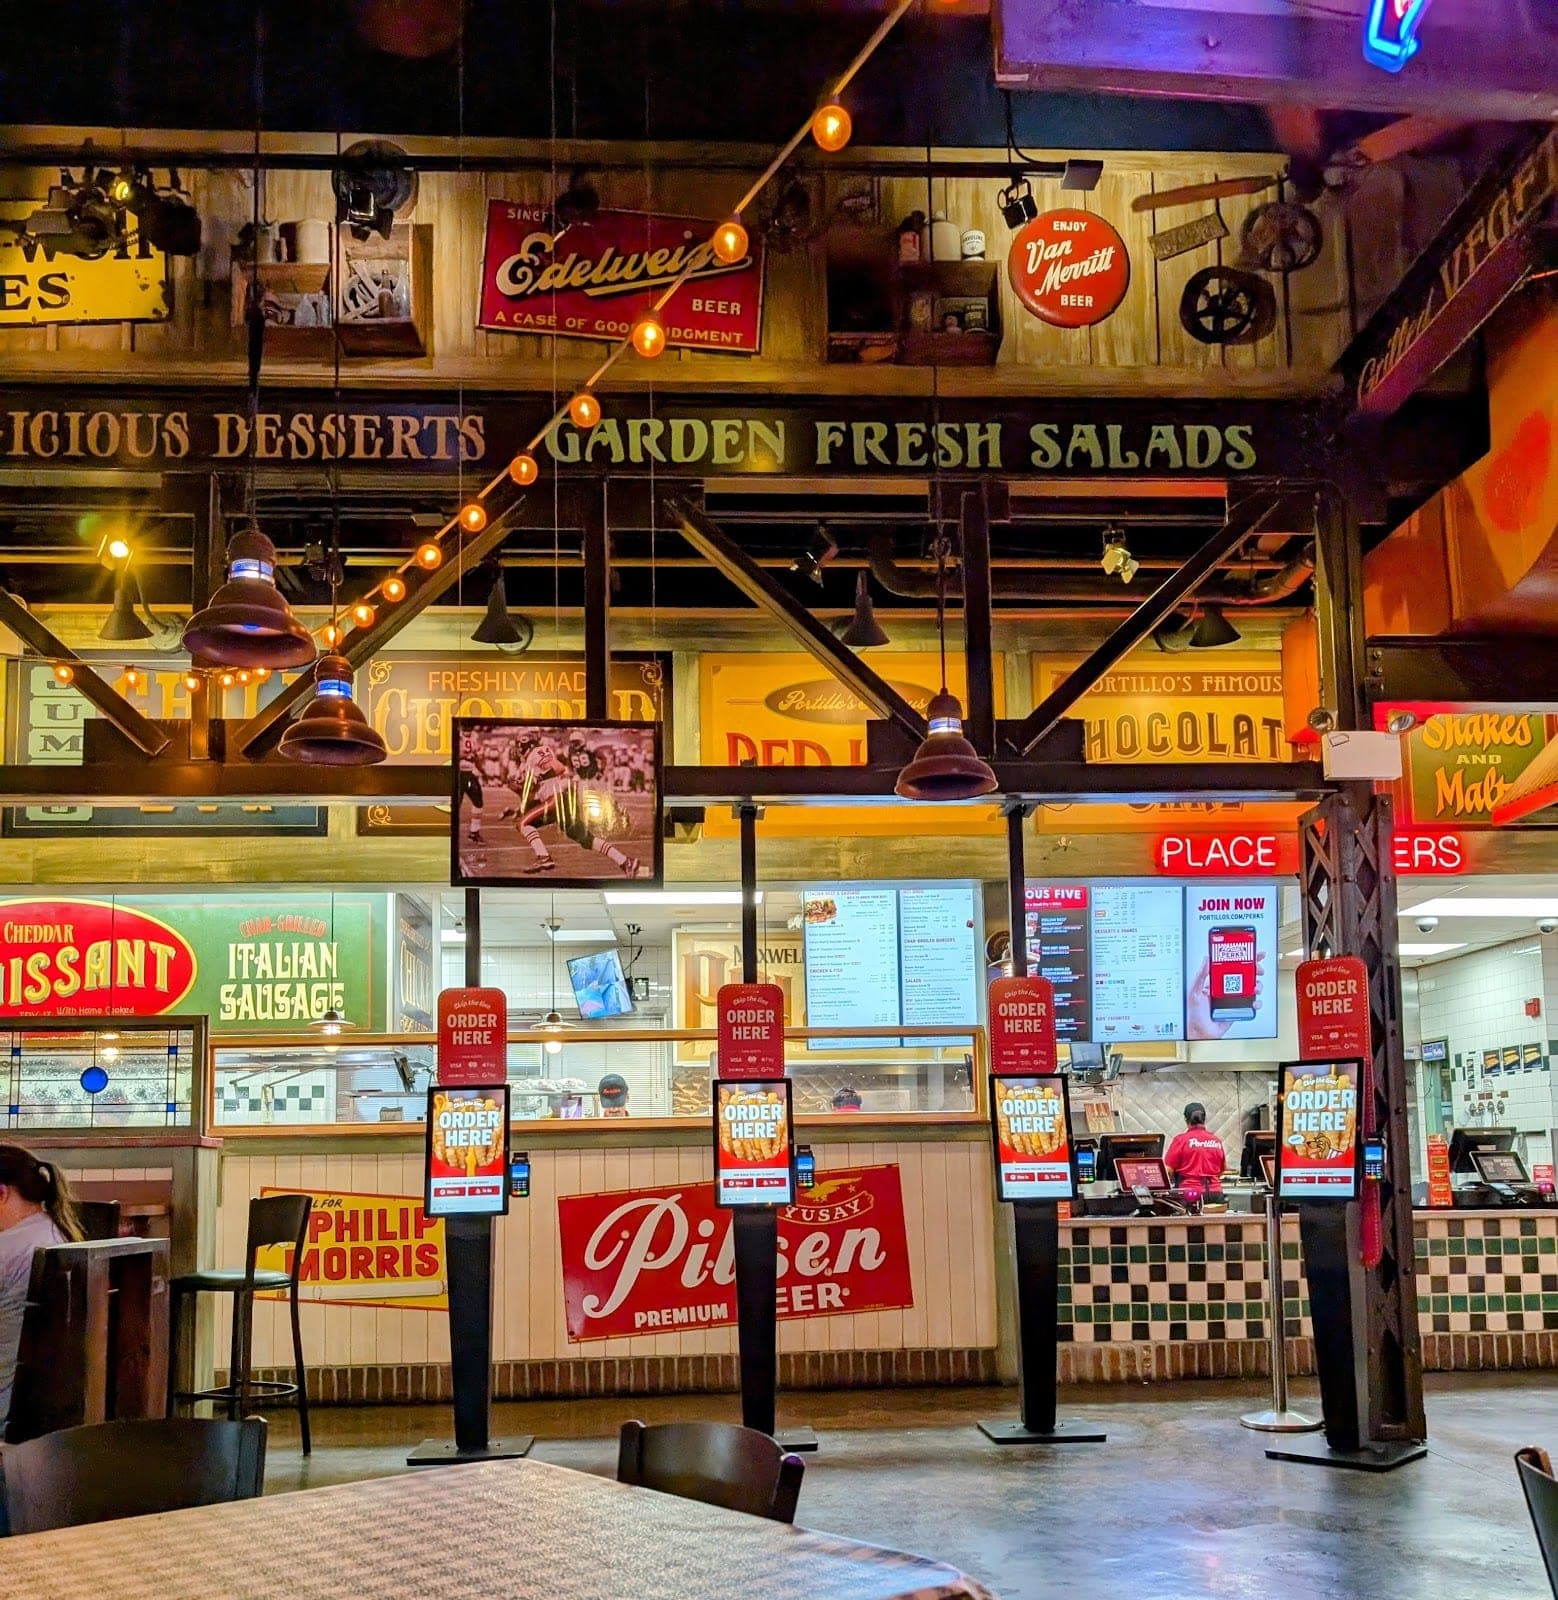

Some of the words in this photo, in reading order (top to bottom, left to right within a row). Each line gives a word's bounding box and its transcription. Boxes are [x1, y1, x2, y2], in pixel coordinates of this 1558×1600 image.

[1053, 221, 1088, 231] ENJOY
[1026, 238, 1072, 274] Van
[1034, 246, 1115, 296] Merritt
[692, 299, 741, 315] BEER
[1061, 295, 1093, 307] BEER
[495, 311, 507, 323] A
[513, 312, 557, 326] CASE
[565, 317, 586, 330] OF
[594, 320, 634, 334] GOO
[2, 411, 190, 458] ICIOUS
[213, 413, 486, 462] DESSERTS
[544, 418, 786, 464] GARDEN
[814, 421, 1002, 468] FRESH
[1029, 424, 1258, 469] SALADS
[427, 671, 526, 692] FRESHLY
[532, 671, 587, 692] MAD
[1090, 675, 1193, 694] ORTILLO'S
[1201, 675, 1282, 693] FAMOUS
[1456, 755, 1502, 764] AND
[1161, 836, 1277, 868] PLACE
[1393, 835, 1461, 868] ERS
[1025, 889, 1050, 899] OUS
[1054, 889, 1082, 899] FIVE
[1198, 898, 1230, 912] JOIN
[1234, 897, 1265, 910] NOW
[4, 921, 74, 943] CHEDDAR
[228, 942, 338, 979] ITALIAN
[0, 939, 176, 1007] ISSANT
[1305, 979, 1358, 998] ORDER
[220, 983, 345, 1021] SAUSAGE
[998, 1002, 1047, 1016] ORDER
[1312, 998, 1353, 1015] HERE
[446, 1014, 497, 1028] ORDER
[726, 1009, 775, 1023] ORDER
[732, 1026, 770, 1040] HERE
[1004, 1019, 1042, 1033] HERE
[452, 1031, 492, 1045] HERE
[1002, 1098, 1060, 1115] ORDER
[1287, 1089, 1355, 1110] ORDER
[439, 1110, 500, 1128] ORDER
[724, 1103, 784, 1120] ORDER
[731, 1122, 777, 1138] HERE
[1010, 1116, 1056, 1133] HERE
[1293, 1111, 1347, 1131] HERE
[445, 1129, 493, 1147] HERE
[320, 1199, 343, 1208] FOR
[785, 1199, 860, 1222] YUSAY
[308, 1207, 438, 1243] PHILIP
[285, 1243, 440, 1281] MORRIS
[775, 1282, 846, 1313] EER
[634, 1302, 729, 1329] PREMIUM
